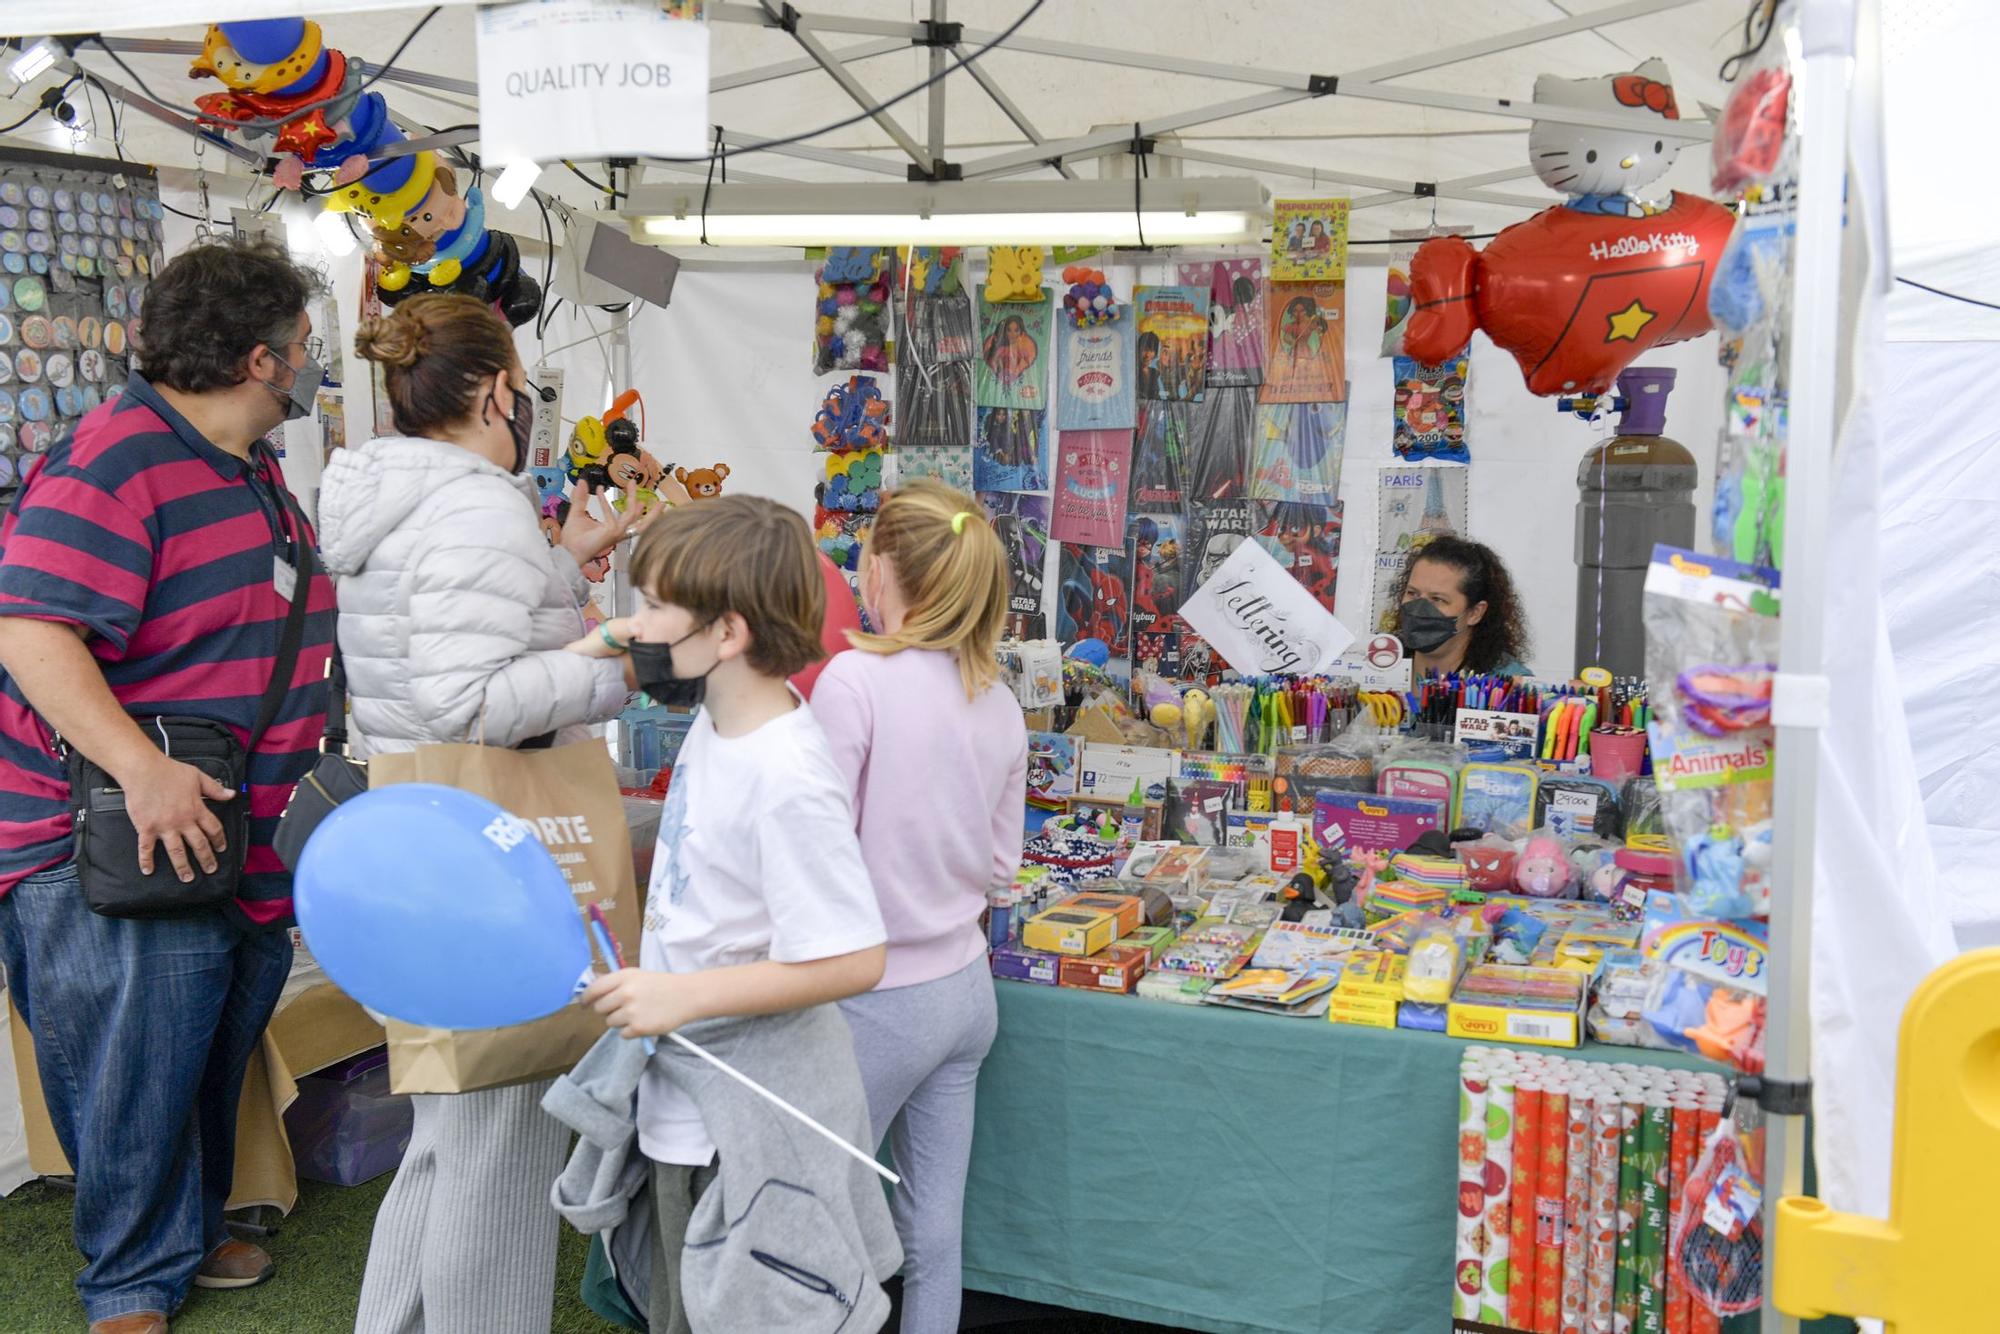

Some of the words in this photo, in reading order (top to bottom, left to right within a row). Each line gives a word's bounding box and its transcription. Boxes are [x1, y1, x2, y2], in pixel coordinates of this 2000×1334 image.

[506, 63, 610, 97] QUALITY
[618, 63, 672, 88] JOB
[1276, 202, 1335, 211] INSPIRATION
[1590, 235, 1650, 261] Hello
[1648, 232, 1700, 256] Kitty
[1076, 350, 1112, 366] friends
[1418, 434, 1439, 443] 200
[1205, 508, 1251, 519] STAR
[1378, 558, 1405, 568] NUE
[1011, 602, 1037, 611] WARS
[1364, 675, 1376, 685] 16
[1460, 717, 1489, 725] STAR
[1460, 723, 1490, 731] WARS
[1672, 744, 1766, 775] Animals
[522, 815, 593, 846] ORTE
[1701, 930, 1763, 977] Toys
[1465, 1021, 1494, 1031] JOVI
[1643, 1181, 1656, 1202] Ho!
[1648, 1207, 1662, 1227] Ho!
[1640, 1284, 1653, 1305] Ho!
